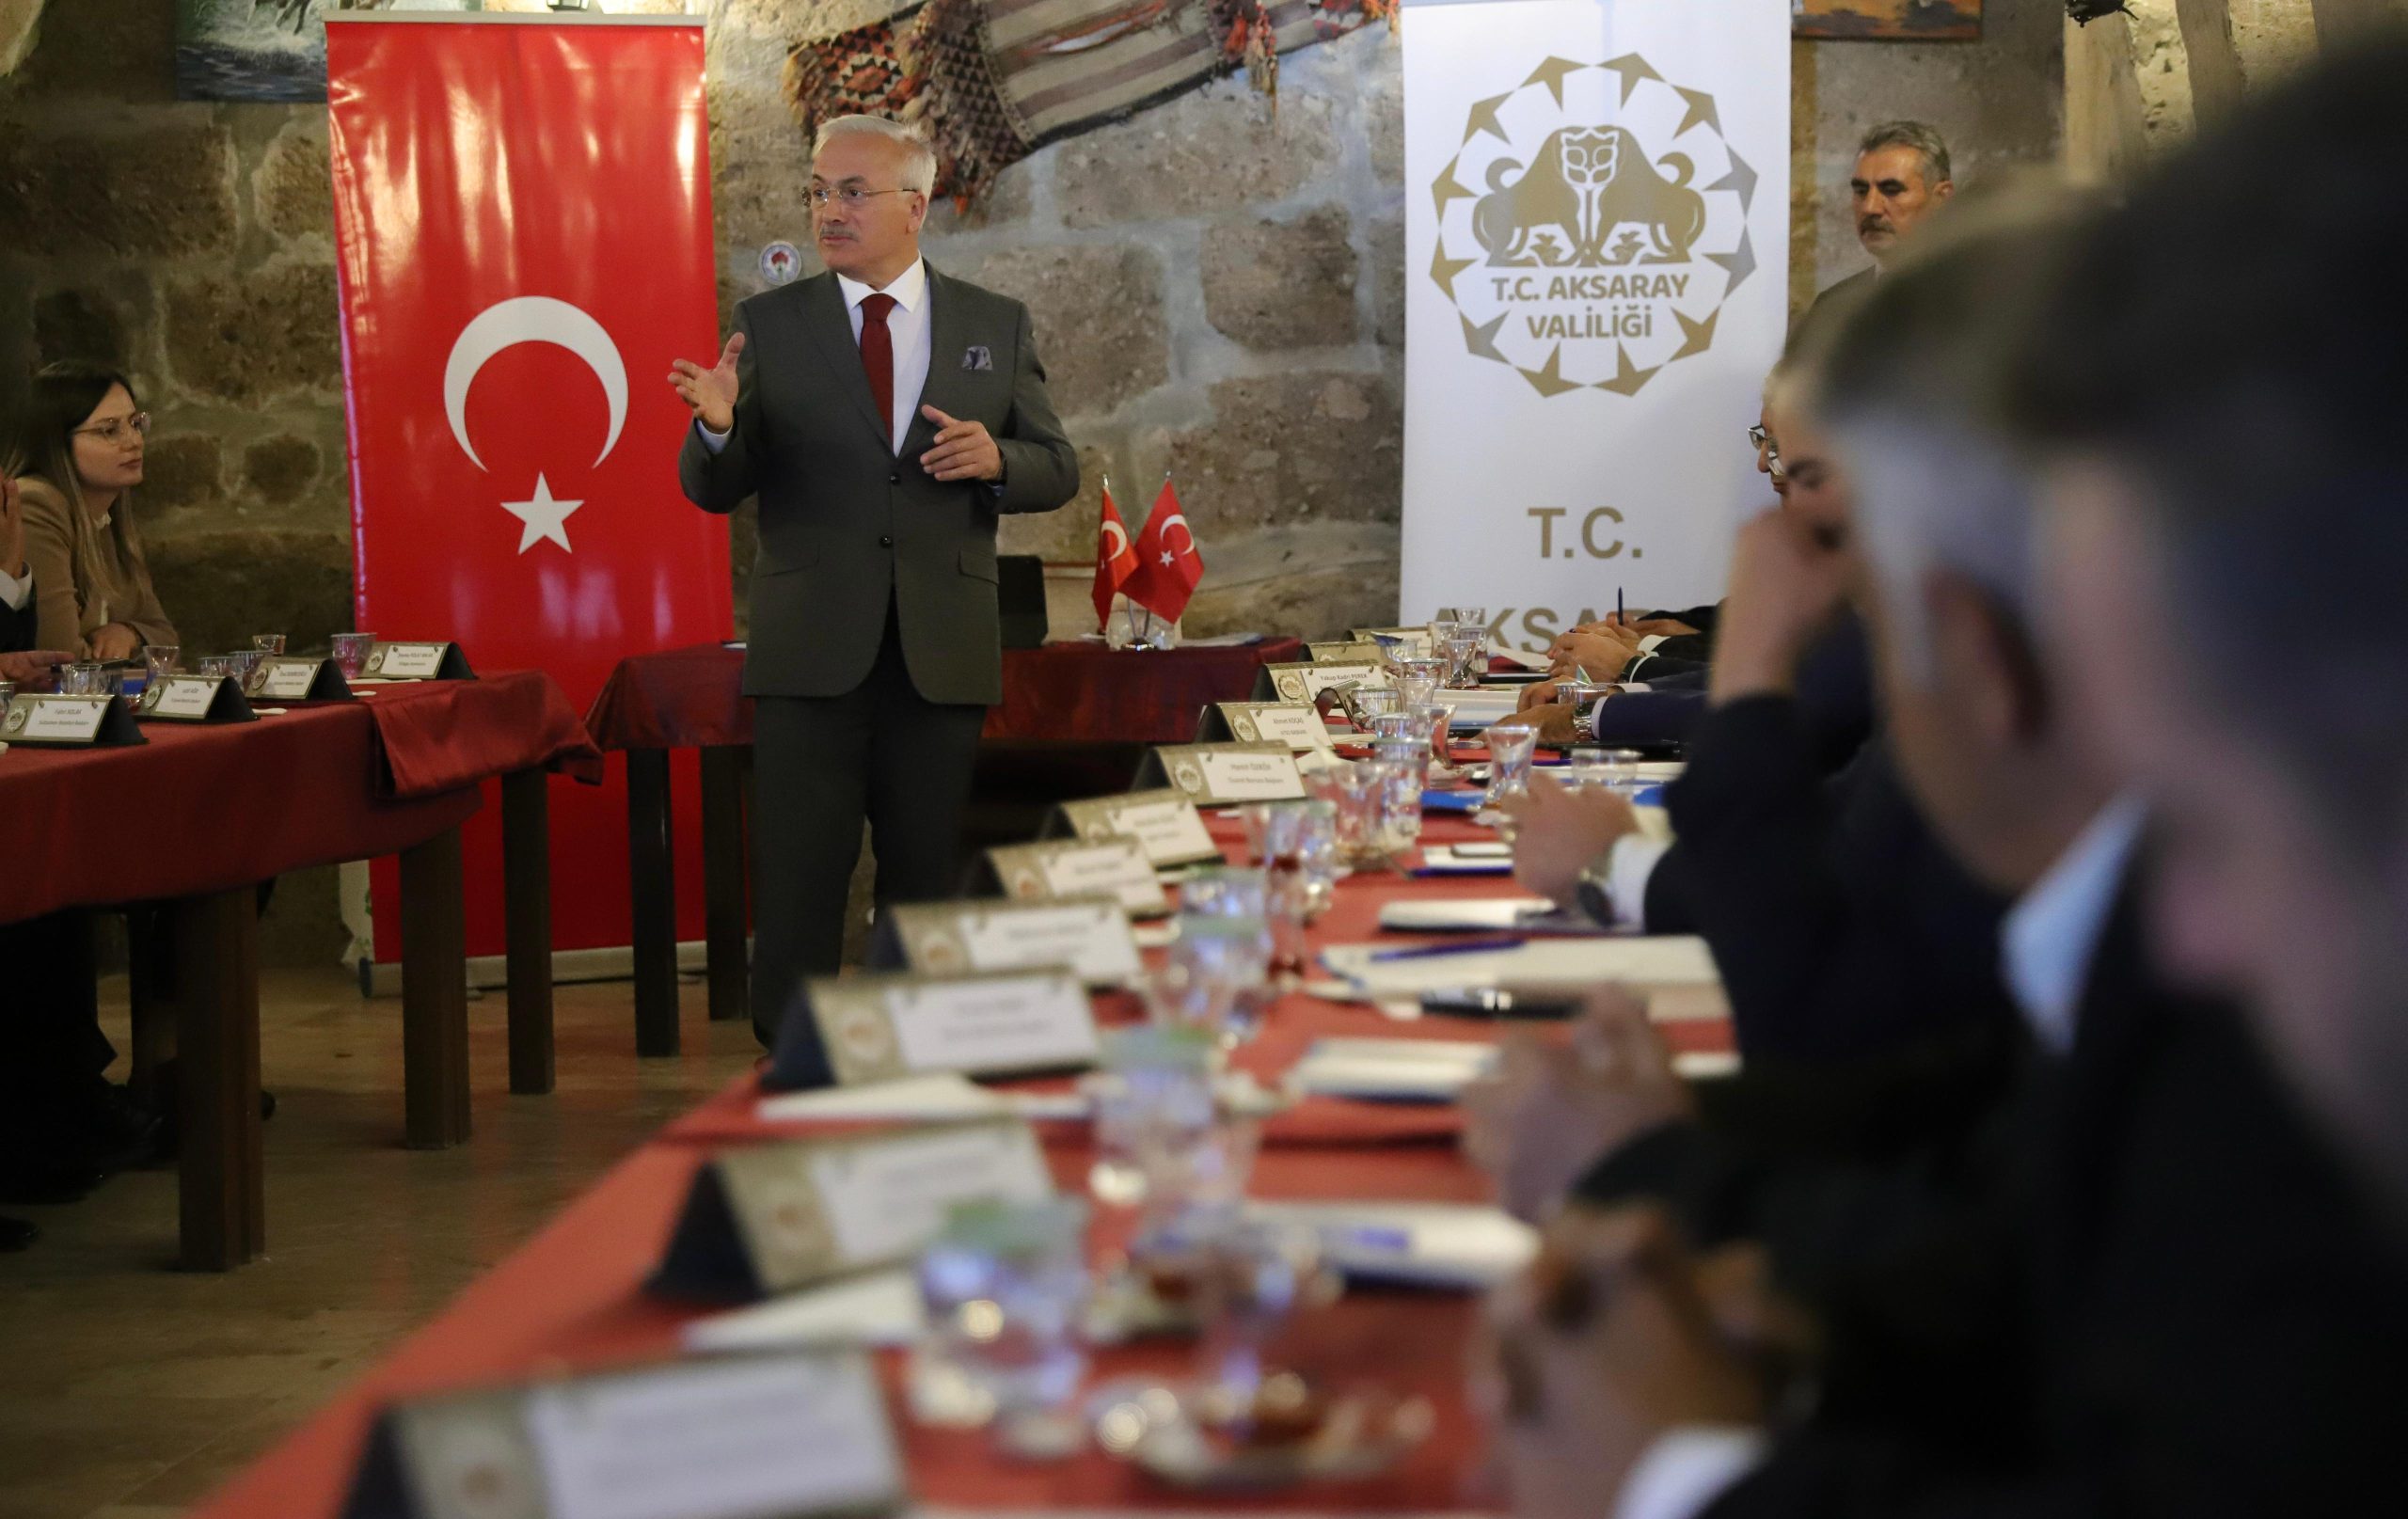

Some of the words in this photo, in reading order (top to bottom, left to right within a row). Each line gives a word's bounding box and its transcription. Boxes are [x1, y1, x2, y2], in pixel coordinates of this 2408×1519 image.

[1491, 277, 1540, 301] T.C.
[1547, 274, 1689, 300] AKSARAY
[1526, 305, 1653, 339] VALİLİĞİ
[1528, 506, 1642, 559] T.C.
